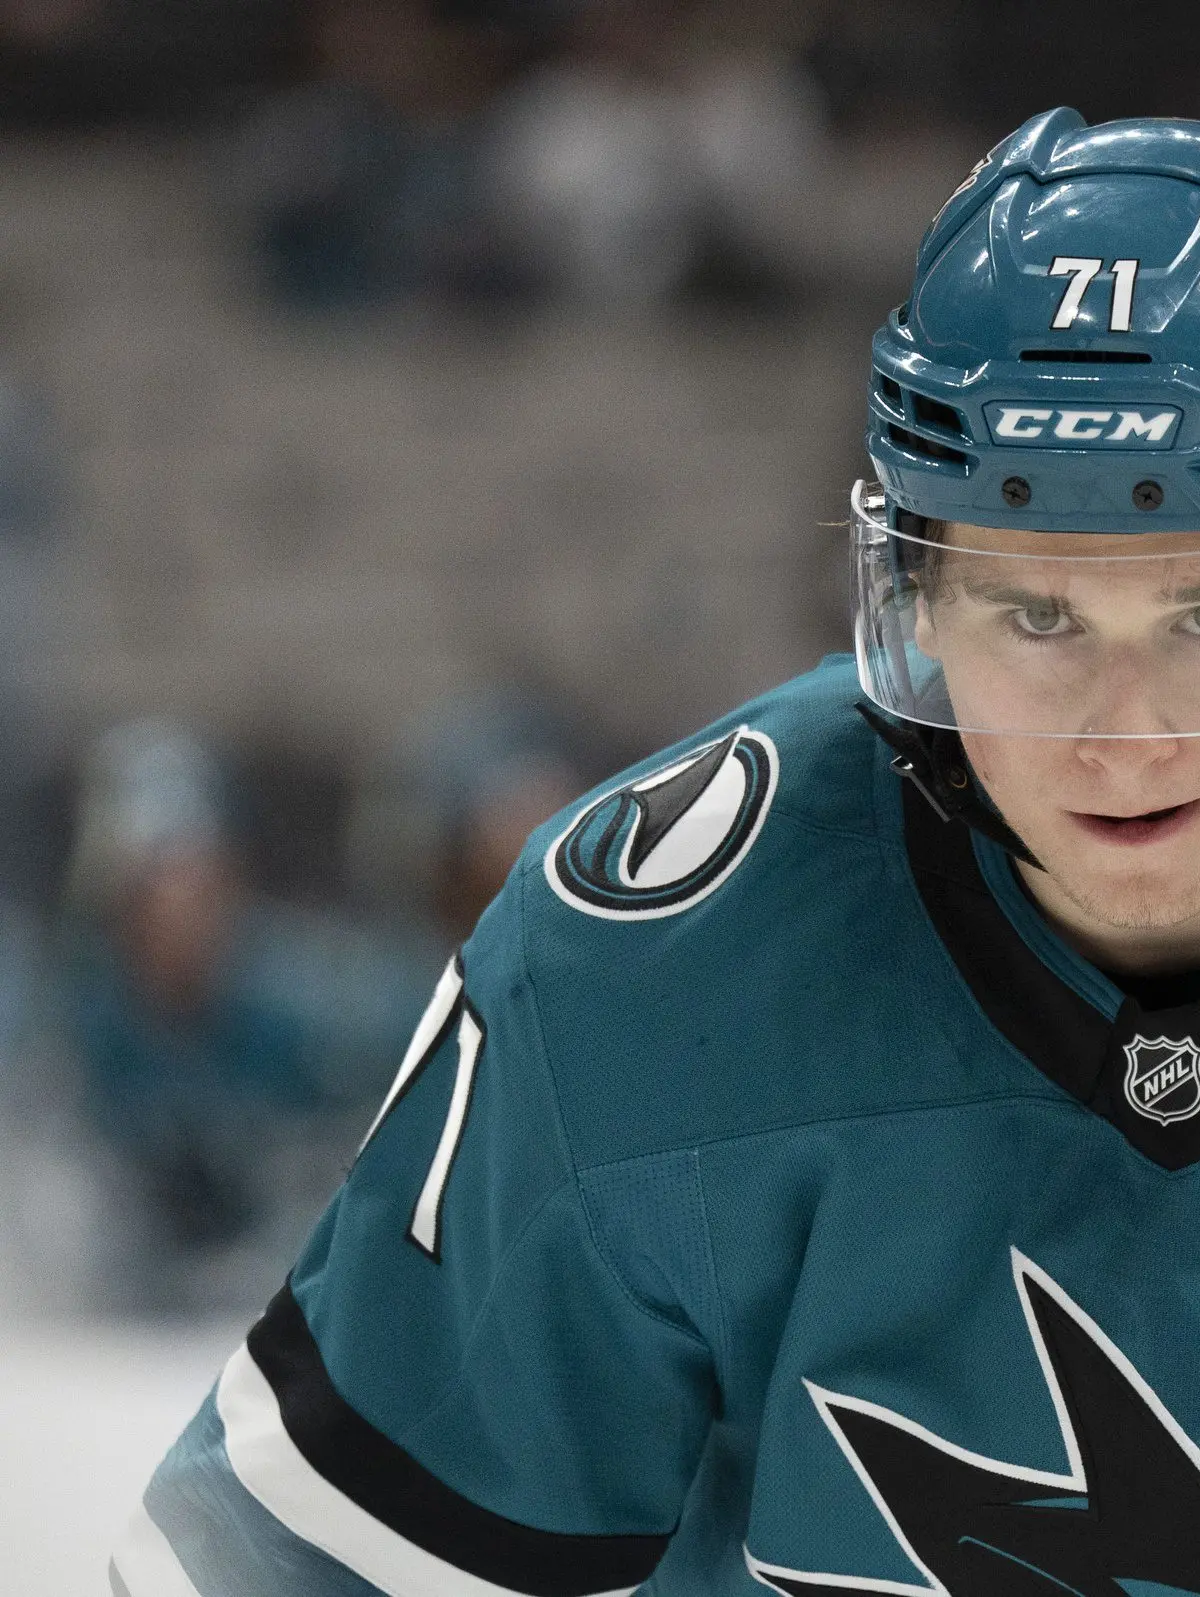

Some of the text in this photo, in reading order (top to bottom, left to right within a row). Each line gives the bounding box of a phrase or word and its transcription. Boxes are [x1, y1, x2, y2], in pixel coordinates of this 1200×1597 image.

[1047, 256, 1140, 333] 71
[995, 408, 1176, 441] CCM
[1143, 1056, 1191, 1102] NHL
